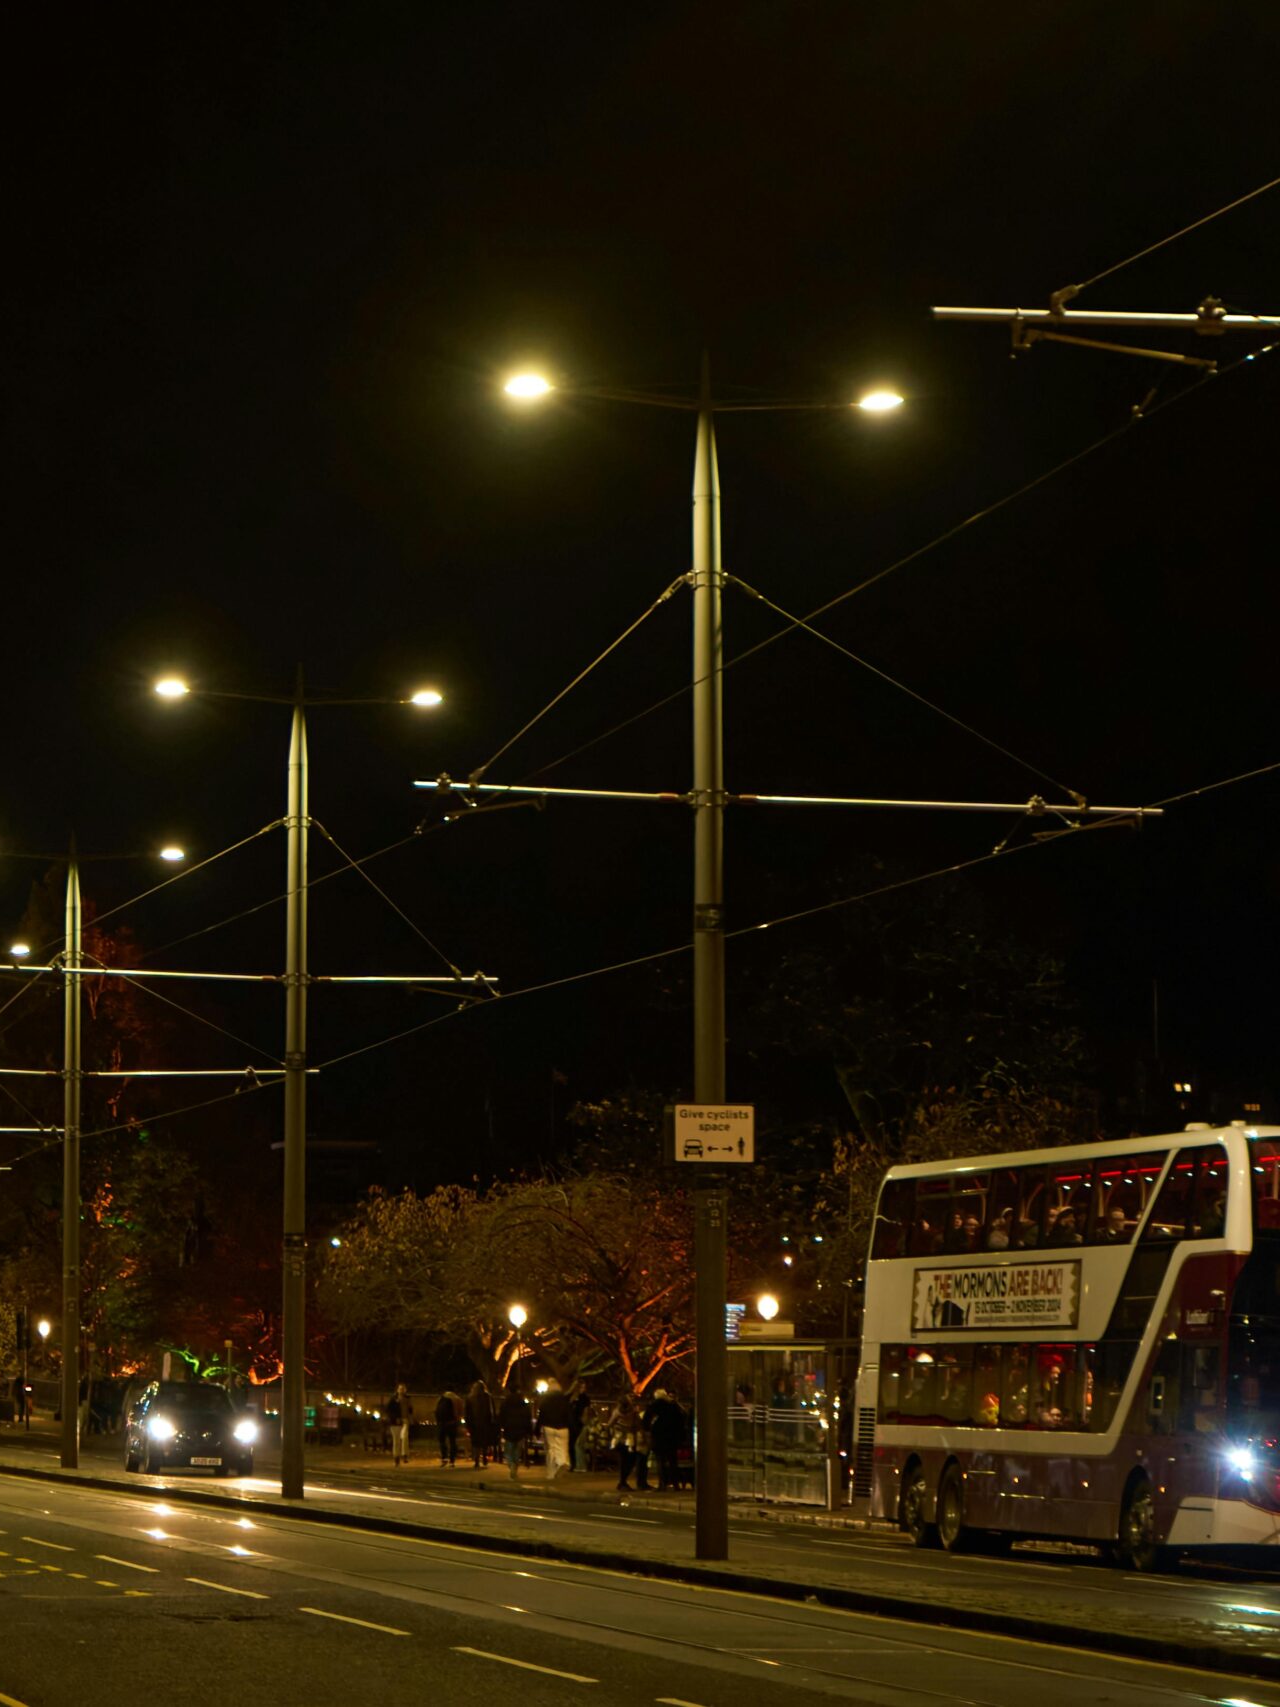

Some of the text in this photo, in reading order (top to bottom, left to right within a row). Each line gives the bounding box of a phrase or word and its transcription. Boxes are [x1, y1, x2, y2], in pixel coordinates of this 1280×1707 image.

[679, 1109, 749, 1121] Give cyclists
[699, 1123, 730, 1132] space
[934, 1268, 1063, 1299] THE MORMONS ARE BACK!
